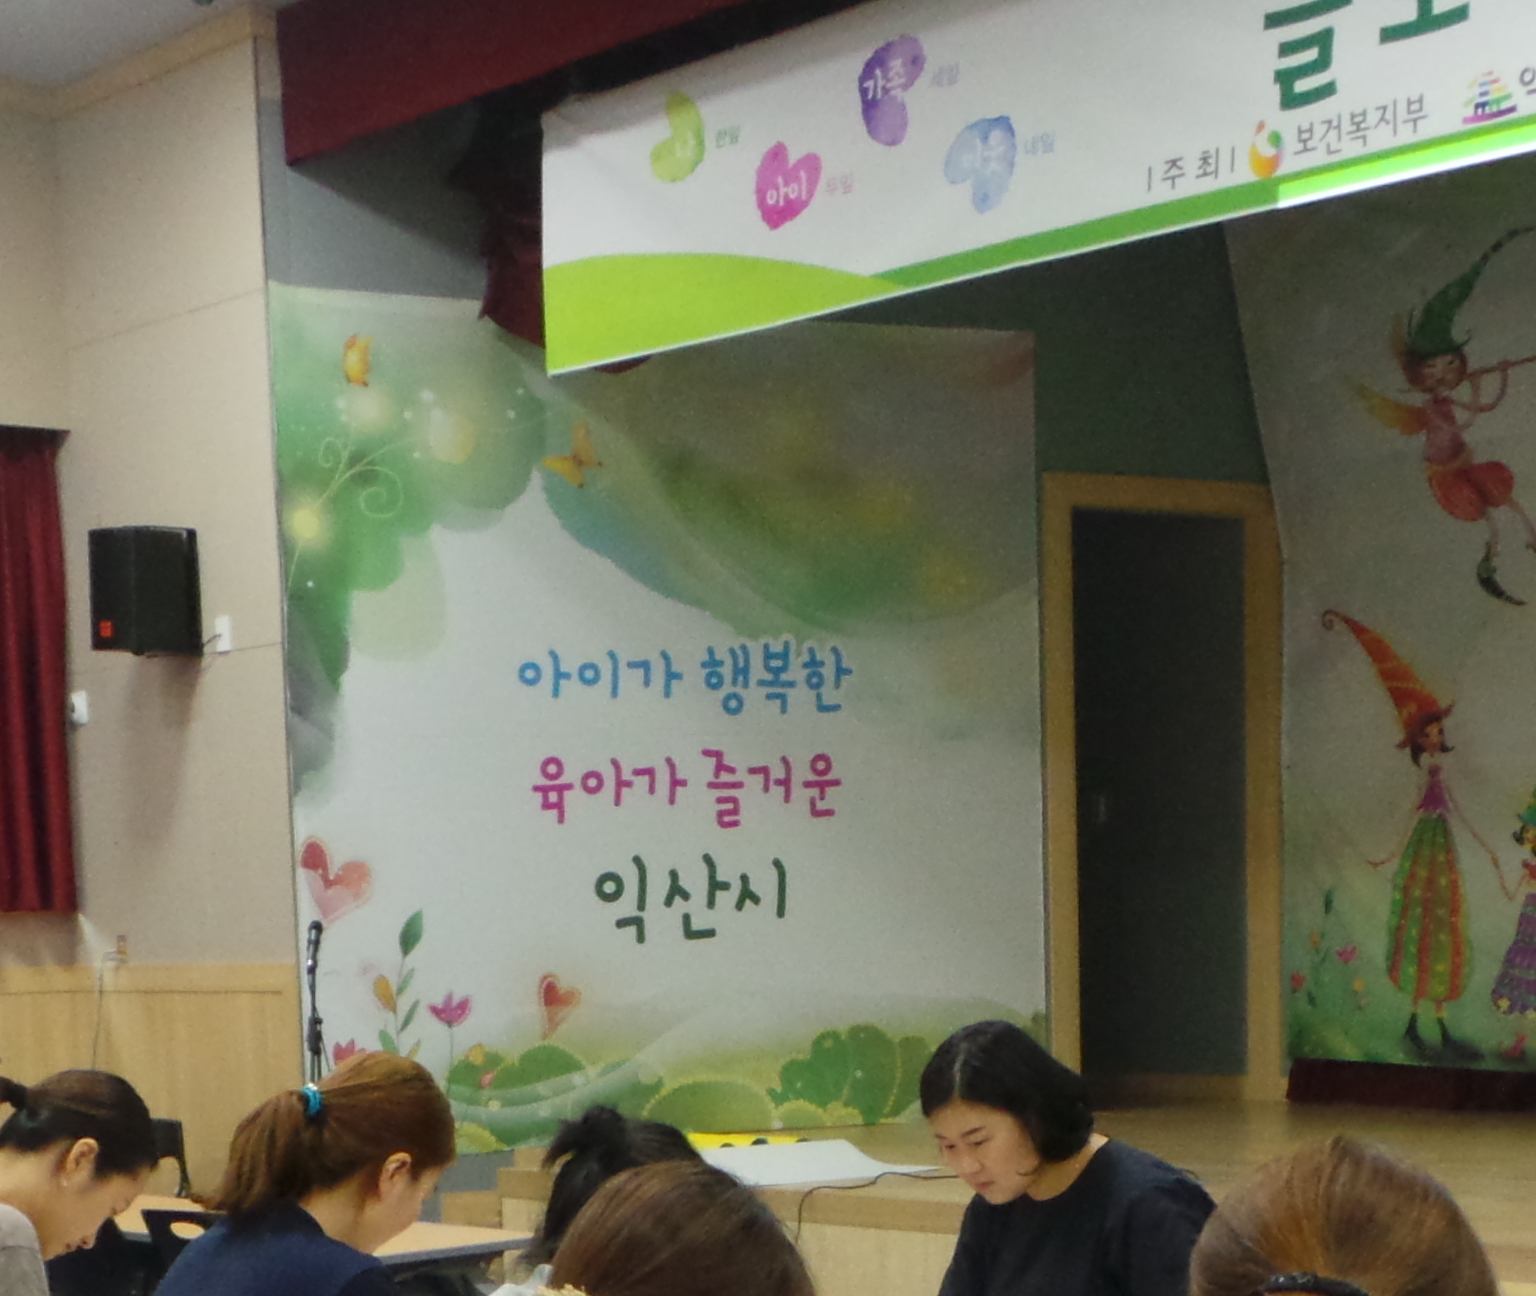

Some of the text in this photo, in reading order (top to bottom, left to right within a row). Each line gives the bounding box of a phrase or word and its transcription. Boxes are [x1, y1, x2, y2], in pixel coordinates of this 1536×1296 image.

[863, 59, 905, 101] 가족
[1293, 94, 1428, 156] 보건복지부
[767, 169, 806, 206] 아이
[517, 640, 853, 716] 아이가 행복한
[532, 748, 843, 829] 육아가 즐거운
[594, 853, 788, 944] 익산시
